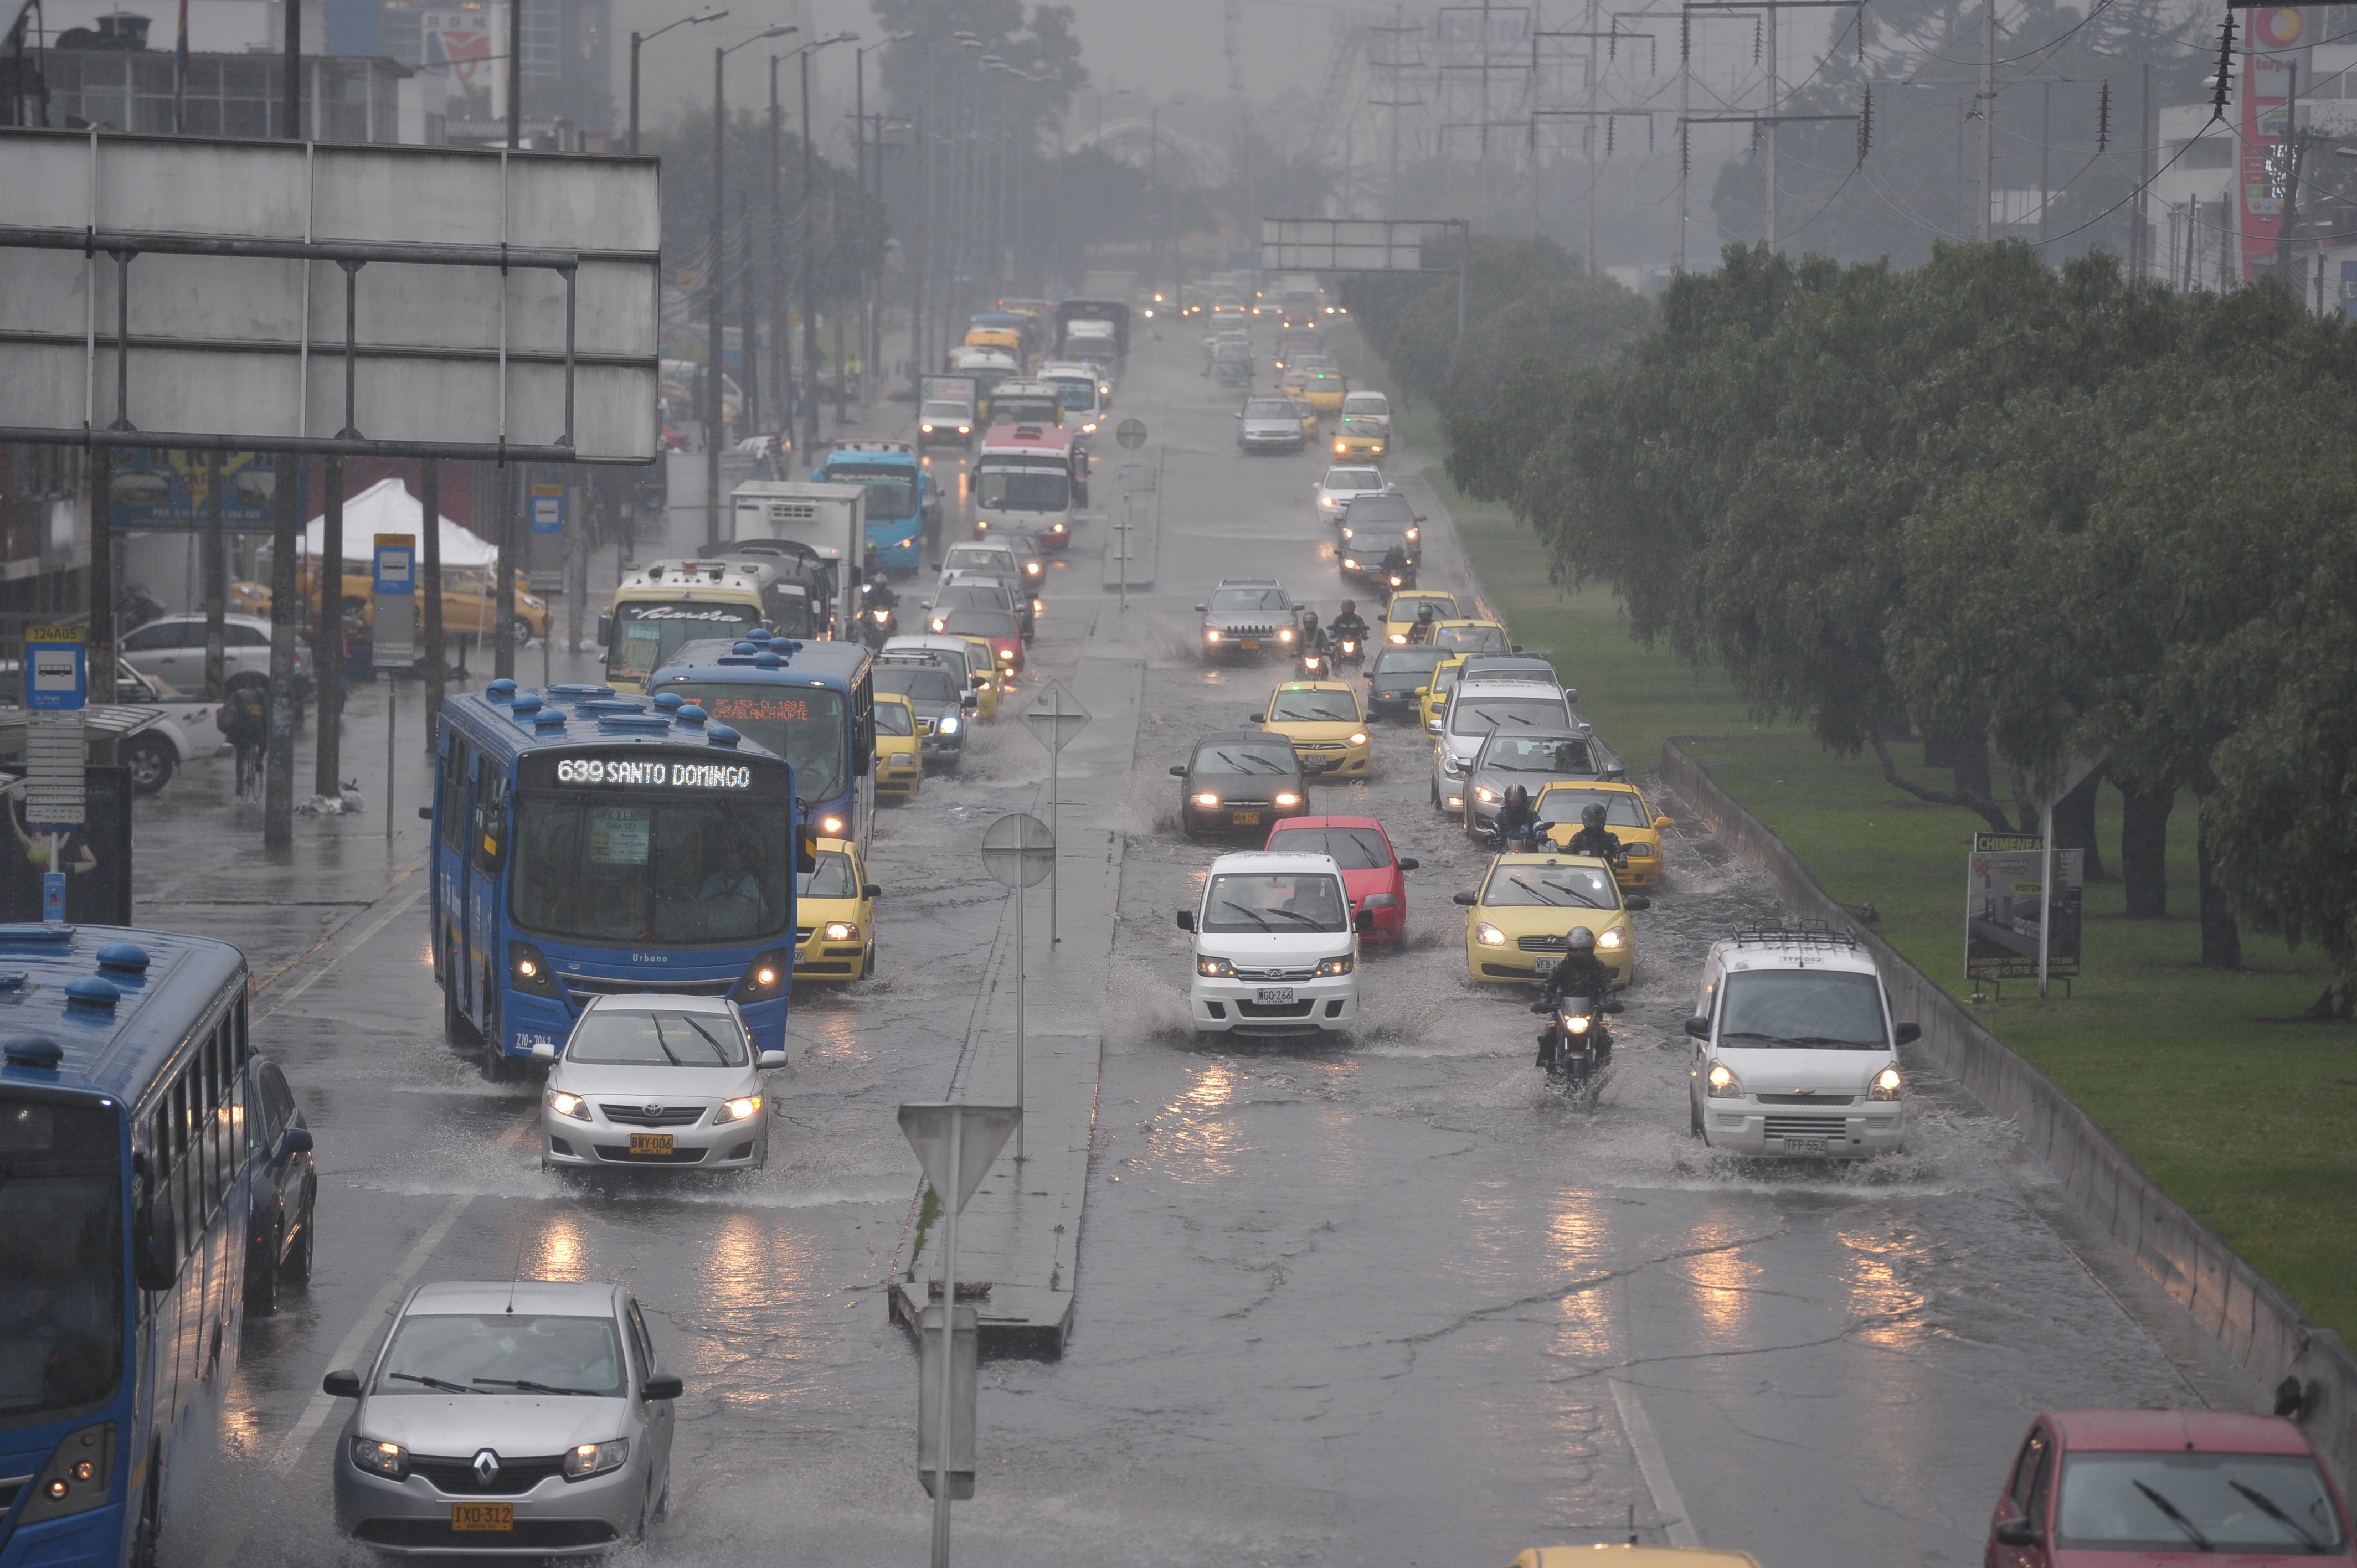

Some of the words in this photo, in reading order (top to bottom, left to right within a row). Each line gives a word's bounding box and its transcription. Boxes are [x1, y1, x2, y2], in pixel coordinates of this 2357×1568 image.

[34, 628, 76, 639] 124A05
[713, 708, 776, 719] CASABLANCA
[777, 710, 809, 720] NORTE
[558, 760, 604, 782] 639
[606, 761, 665, 785] SANTO
[672, 764, 750, 788] DOMINGO
[612, 810, 631, 819] 639
[1979, 837, 2044, 851] CHIMENEA
[632, 953, 668, 962] Urbano
